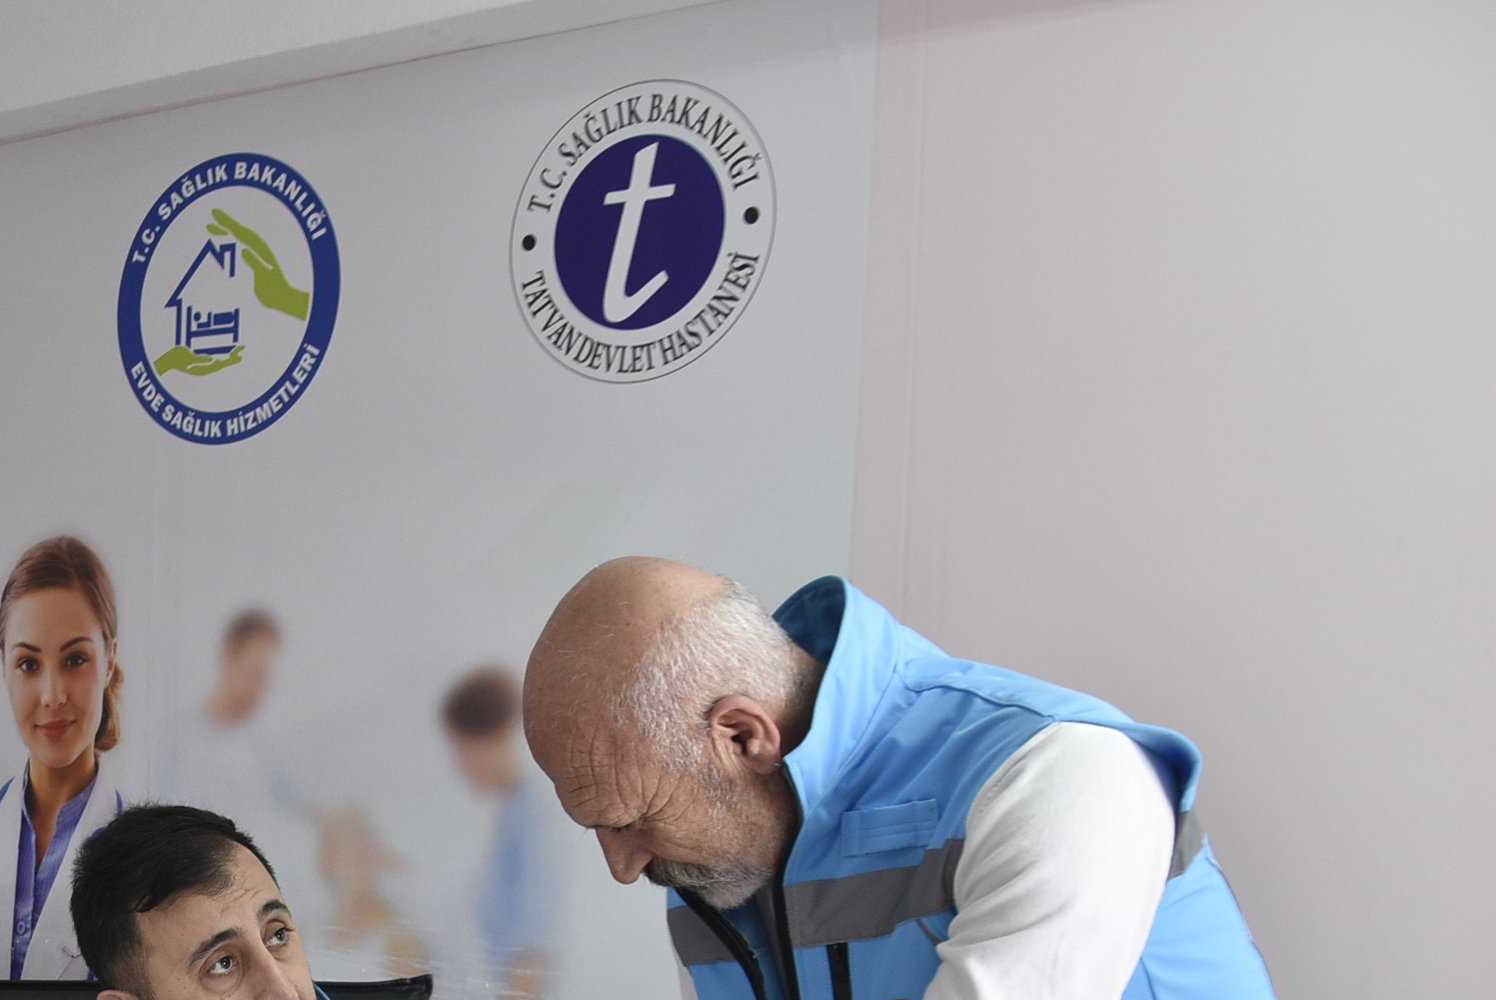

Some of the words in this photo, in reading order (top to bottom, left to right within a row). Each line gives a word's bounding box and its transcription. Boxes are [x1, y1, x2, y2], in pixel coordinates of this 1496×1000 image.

[527, 168, 568, 213] T.C.
[558, 95, 643, 167] SAĞLIK
[647, 93, 762, 191] BAKANLIĞI
[132, 226, 161, 264] T.C.
[158, 162, 229, 221] SAĞLIK
[234, 161, 327, 240] BAKANLIĞI
[522, 270, 583, 356] TATVAN
[573, 335, 662, 374] DEVLET
[657, 252, 760, 366] HASTANESİ
[131, 360, 166, 412] EVDE
[161, 405, 222, 438] SAĞLIK
[226, 343, 320, 436] HİZMETLERİ
